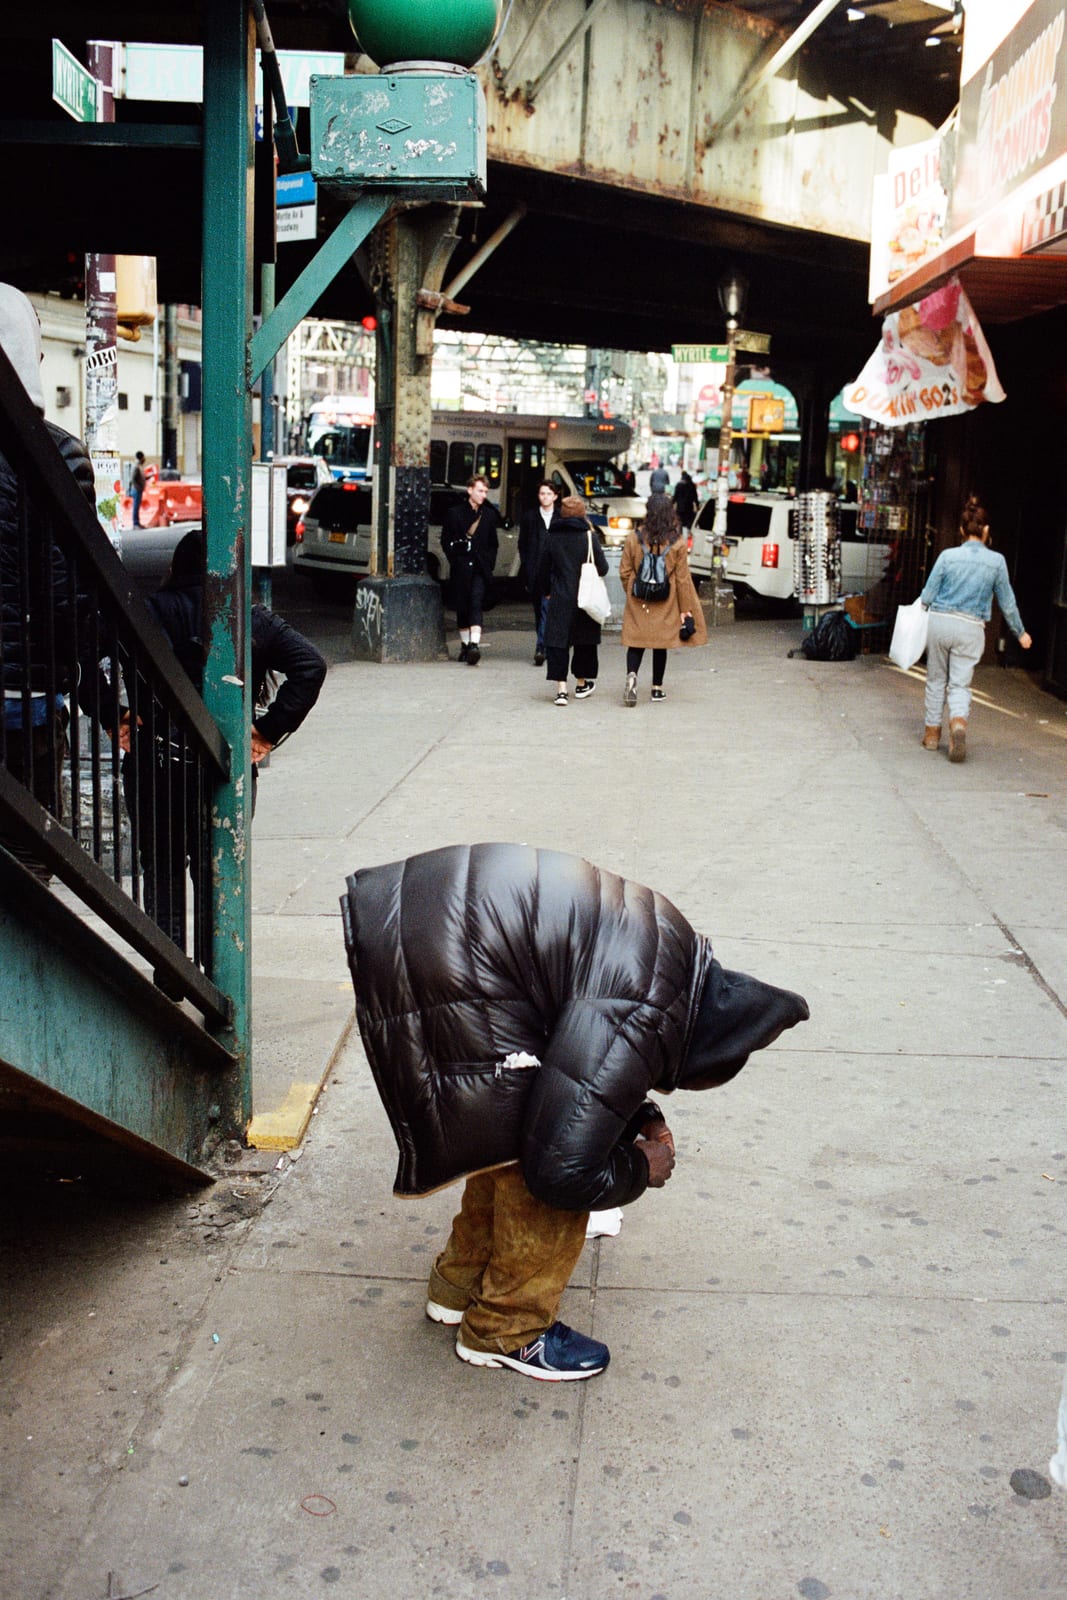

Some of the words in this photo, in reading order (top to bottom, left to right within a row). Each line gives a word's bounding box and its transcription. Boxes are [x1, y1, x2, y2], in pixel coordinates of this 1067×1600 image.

[55, 46, 85, 118] MYRTLE
[87, 349, 116, 370] OBO
[673, 347, 712, 362] MYRTLE
